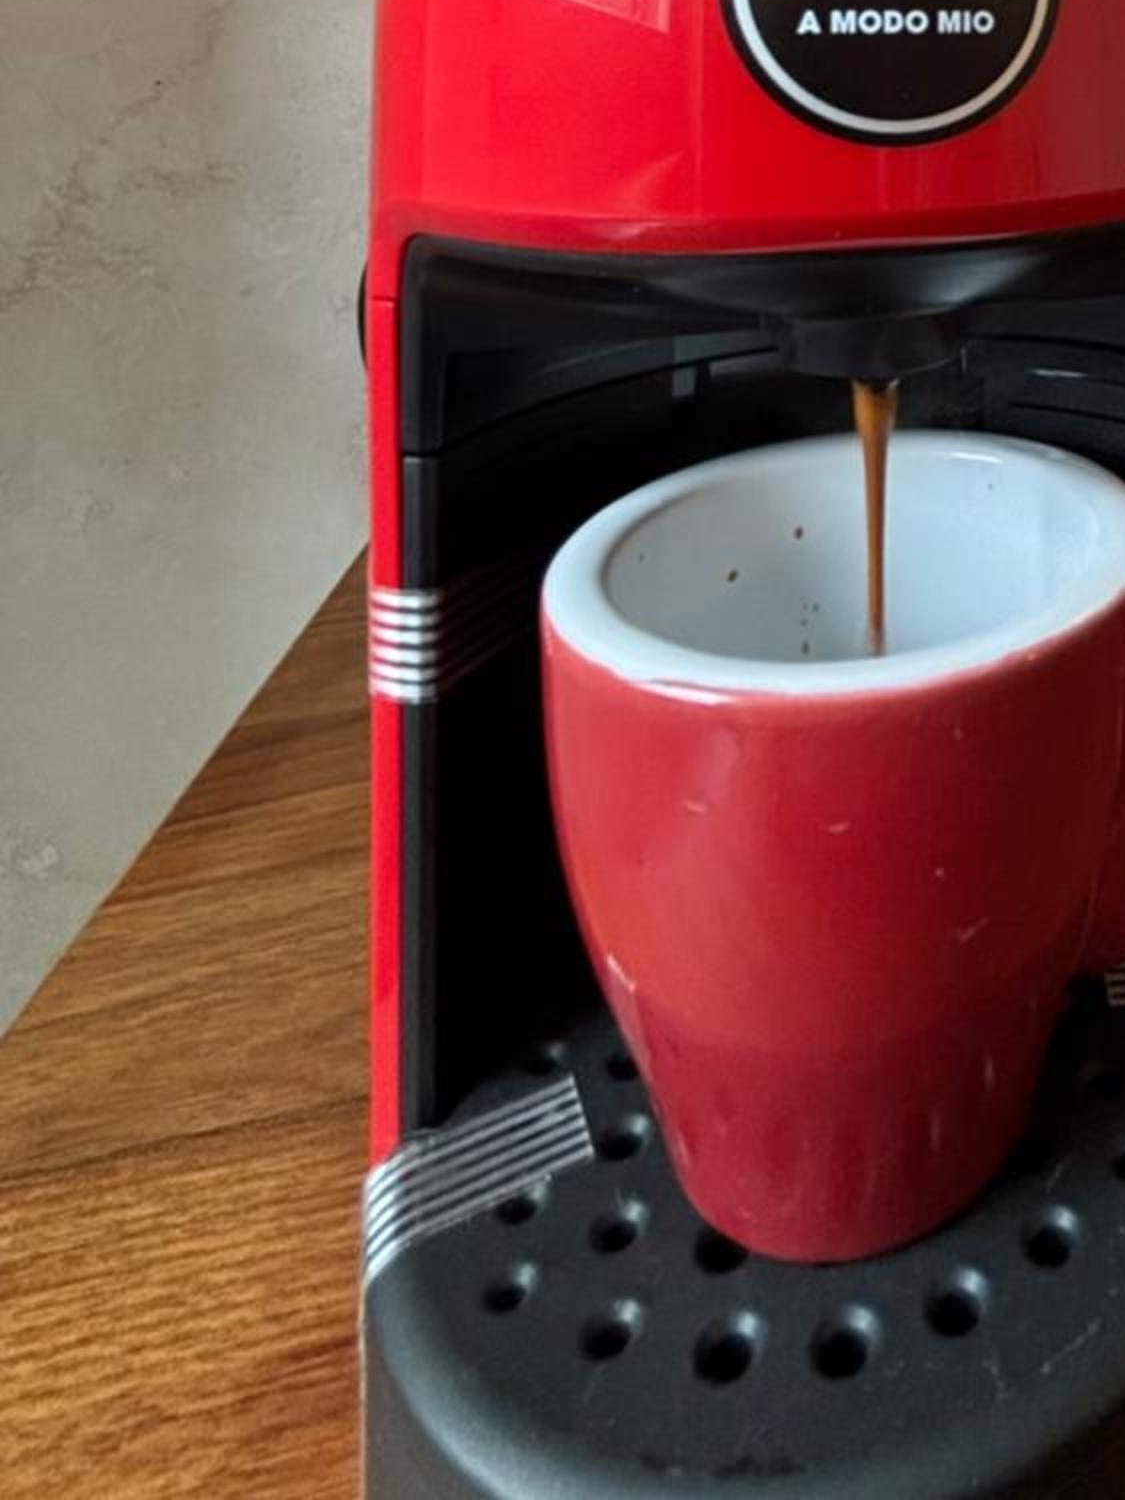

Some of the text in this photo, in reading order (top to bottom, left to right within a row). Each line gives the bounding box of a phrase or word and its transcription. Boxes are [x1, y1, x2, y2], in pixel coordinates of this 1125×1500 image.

[797, 10, 995, 34] A MODO MIO
